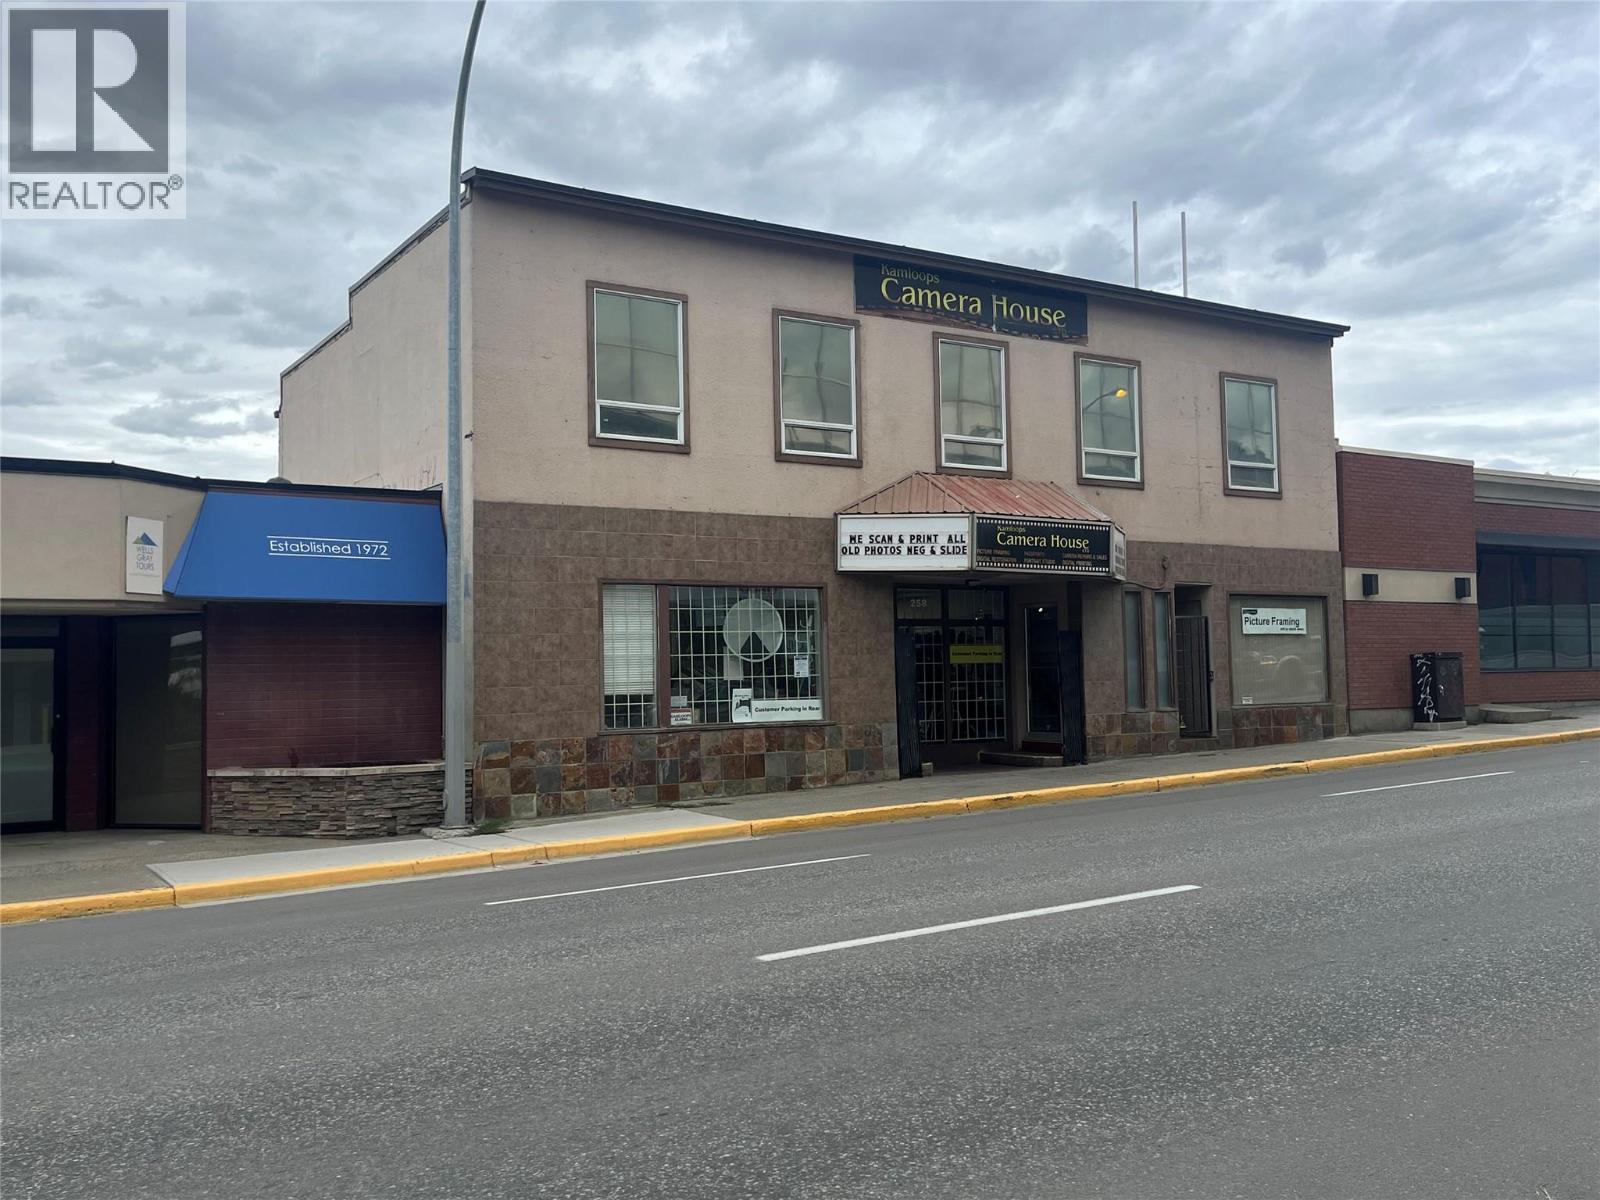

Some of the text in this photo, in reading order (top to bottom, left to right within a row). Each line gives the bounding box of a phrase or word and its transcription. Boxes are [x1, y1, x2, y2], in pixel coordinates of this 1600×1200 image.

[880, 263, 941, 285] Kamloops
[881, 277, 1067, 329] Camera House
[849, 534, 966, 544] WE SCAN & PRINT ALL
[996, 531, 1090, 549] Camera House
[269, 540, 388, 556] Established 1972
[841, 545, 967, 555] OLD PHOTOS NEG & SLIDE
[910, 599, 928, 608] 258
[1244, 616, 1300, 628] Picture Framing
[781, 705, 802, 713] Parking
